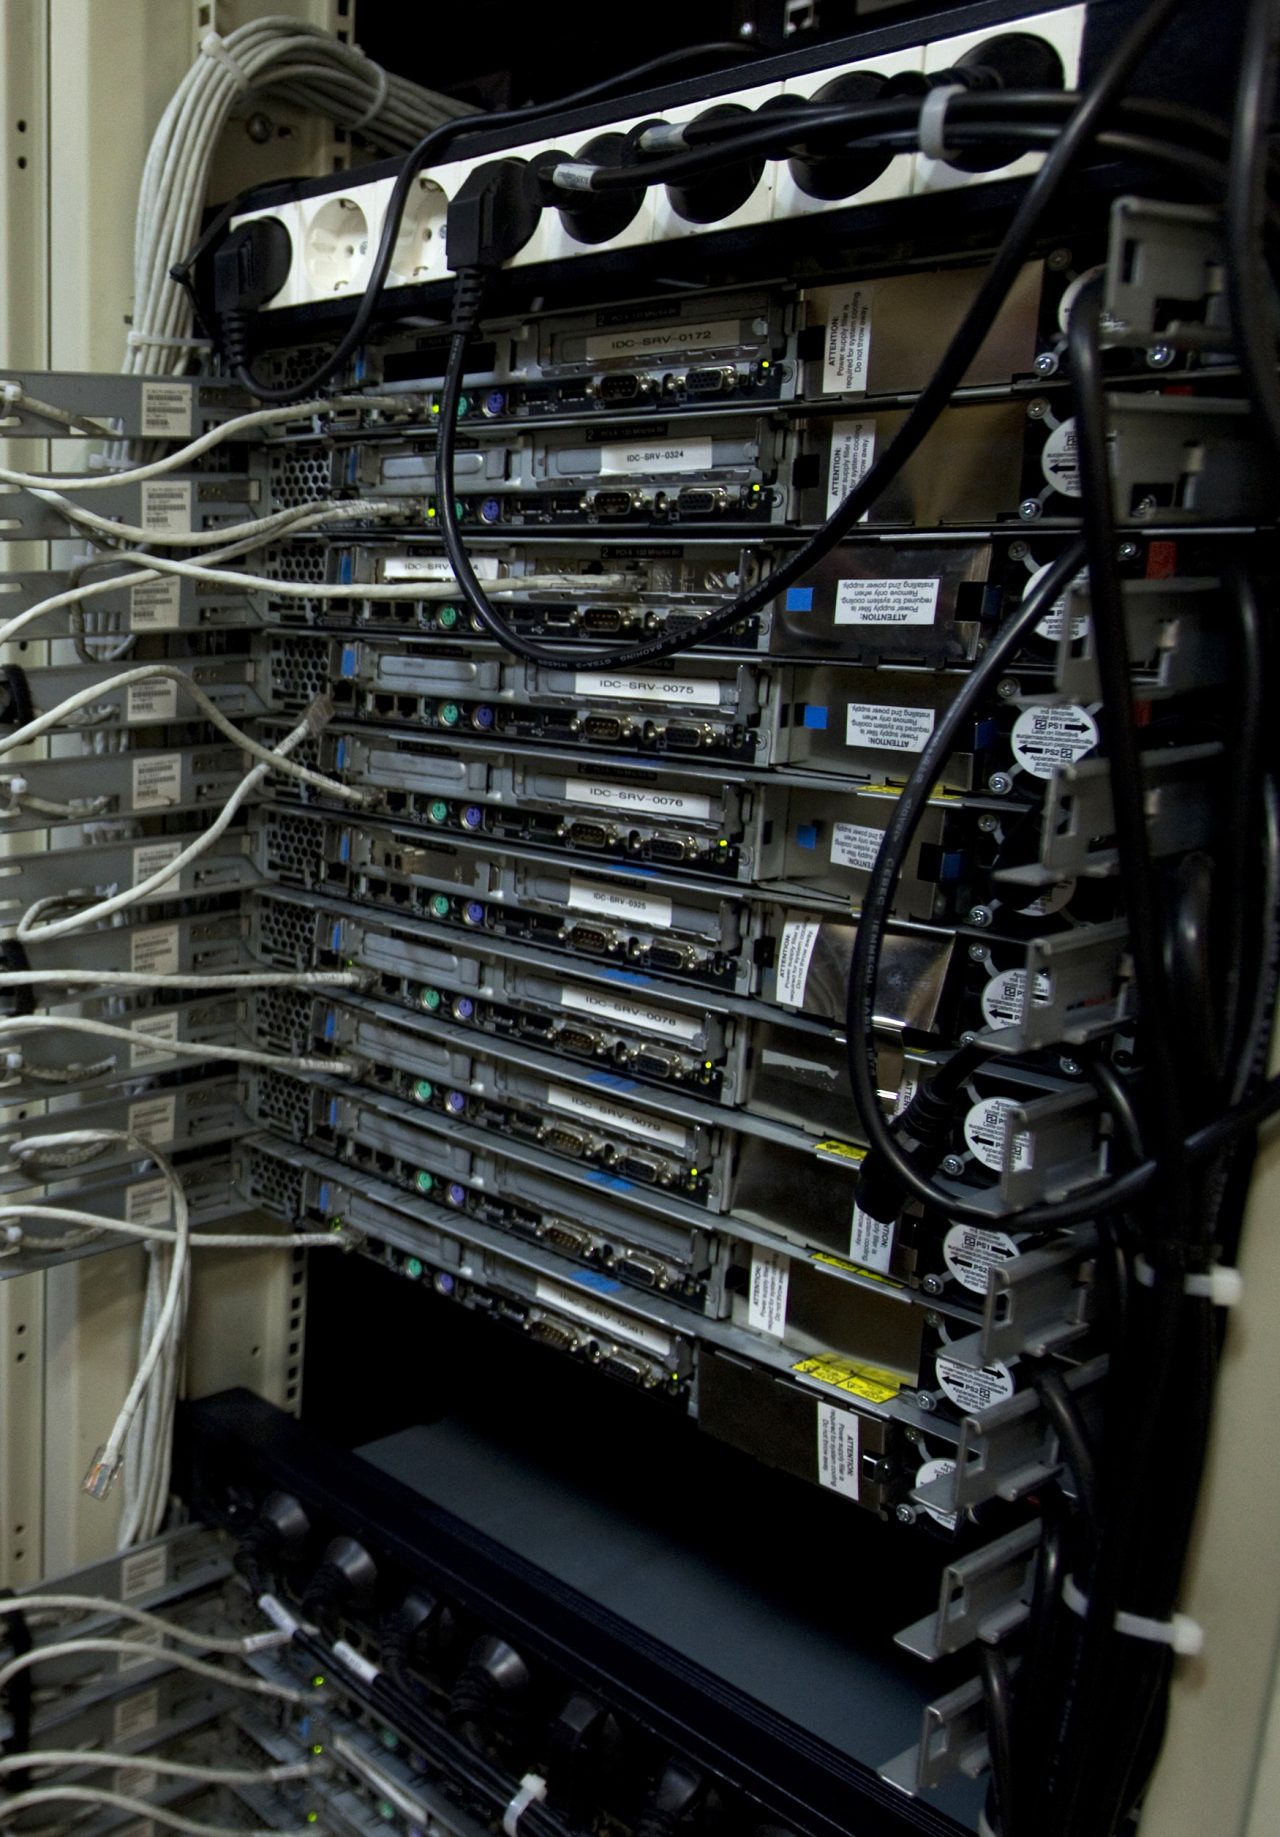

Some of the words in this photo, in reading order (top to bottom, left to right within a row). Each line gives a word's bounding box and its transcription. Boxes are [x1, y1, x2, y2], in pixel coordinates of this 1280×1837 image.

[612, 330, 712, 348] IDC-SRV-0172
[829, 316, 839, 366] ATTENTION:
[839, 329, 848, 352] supply
[848, 321, 857, 346] system
[846, 359, 854, 388] required
[855, 362, 861, 372] Do
[627, 451, 684, 463] IDC-SRV-0324
[851, 453, 860, 477] system
[832, 448, 841, 496] ATTENTION:
[842, 460, 851, 482] supply
[600, 680, 694, 694] IDC-SRV-0075
[904, 710, 930, 719] installing
[869, 738, 909, 747] ATTENTION:
[880, 731, 898, 739] supply
[590, 788, 683, 807] IDC-SRV-0076
[780, 934, 790, 978] ATTENTION:
[977, 1242, 990, 1250] PS1
[973, 1265, 987, 1273] PS2
[753, 1265, 761, 1305] ATTENTION:
[965, 1384, 979, 1393] PS2
